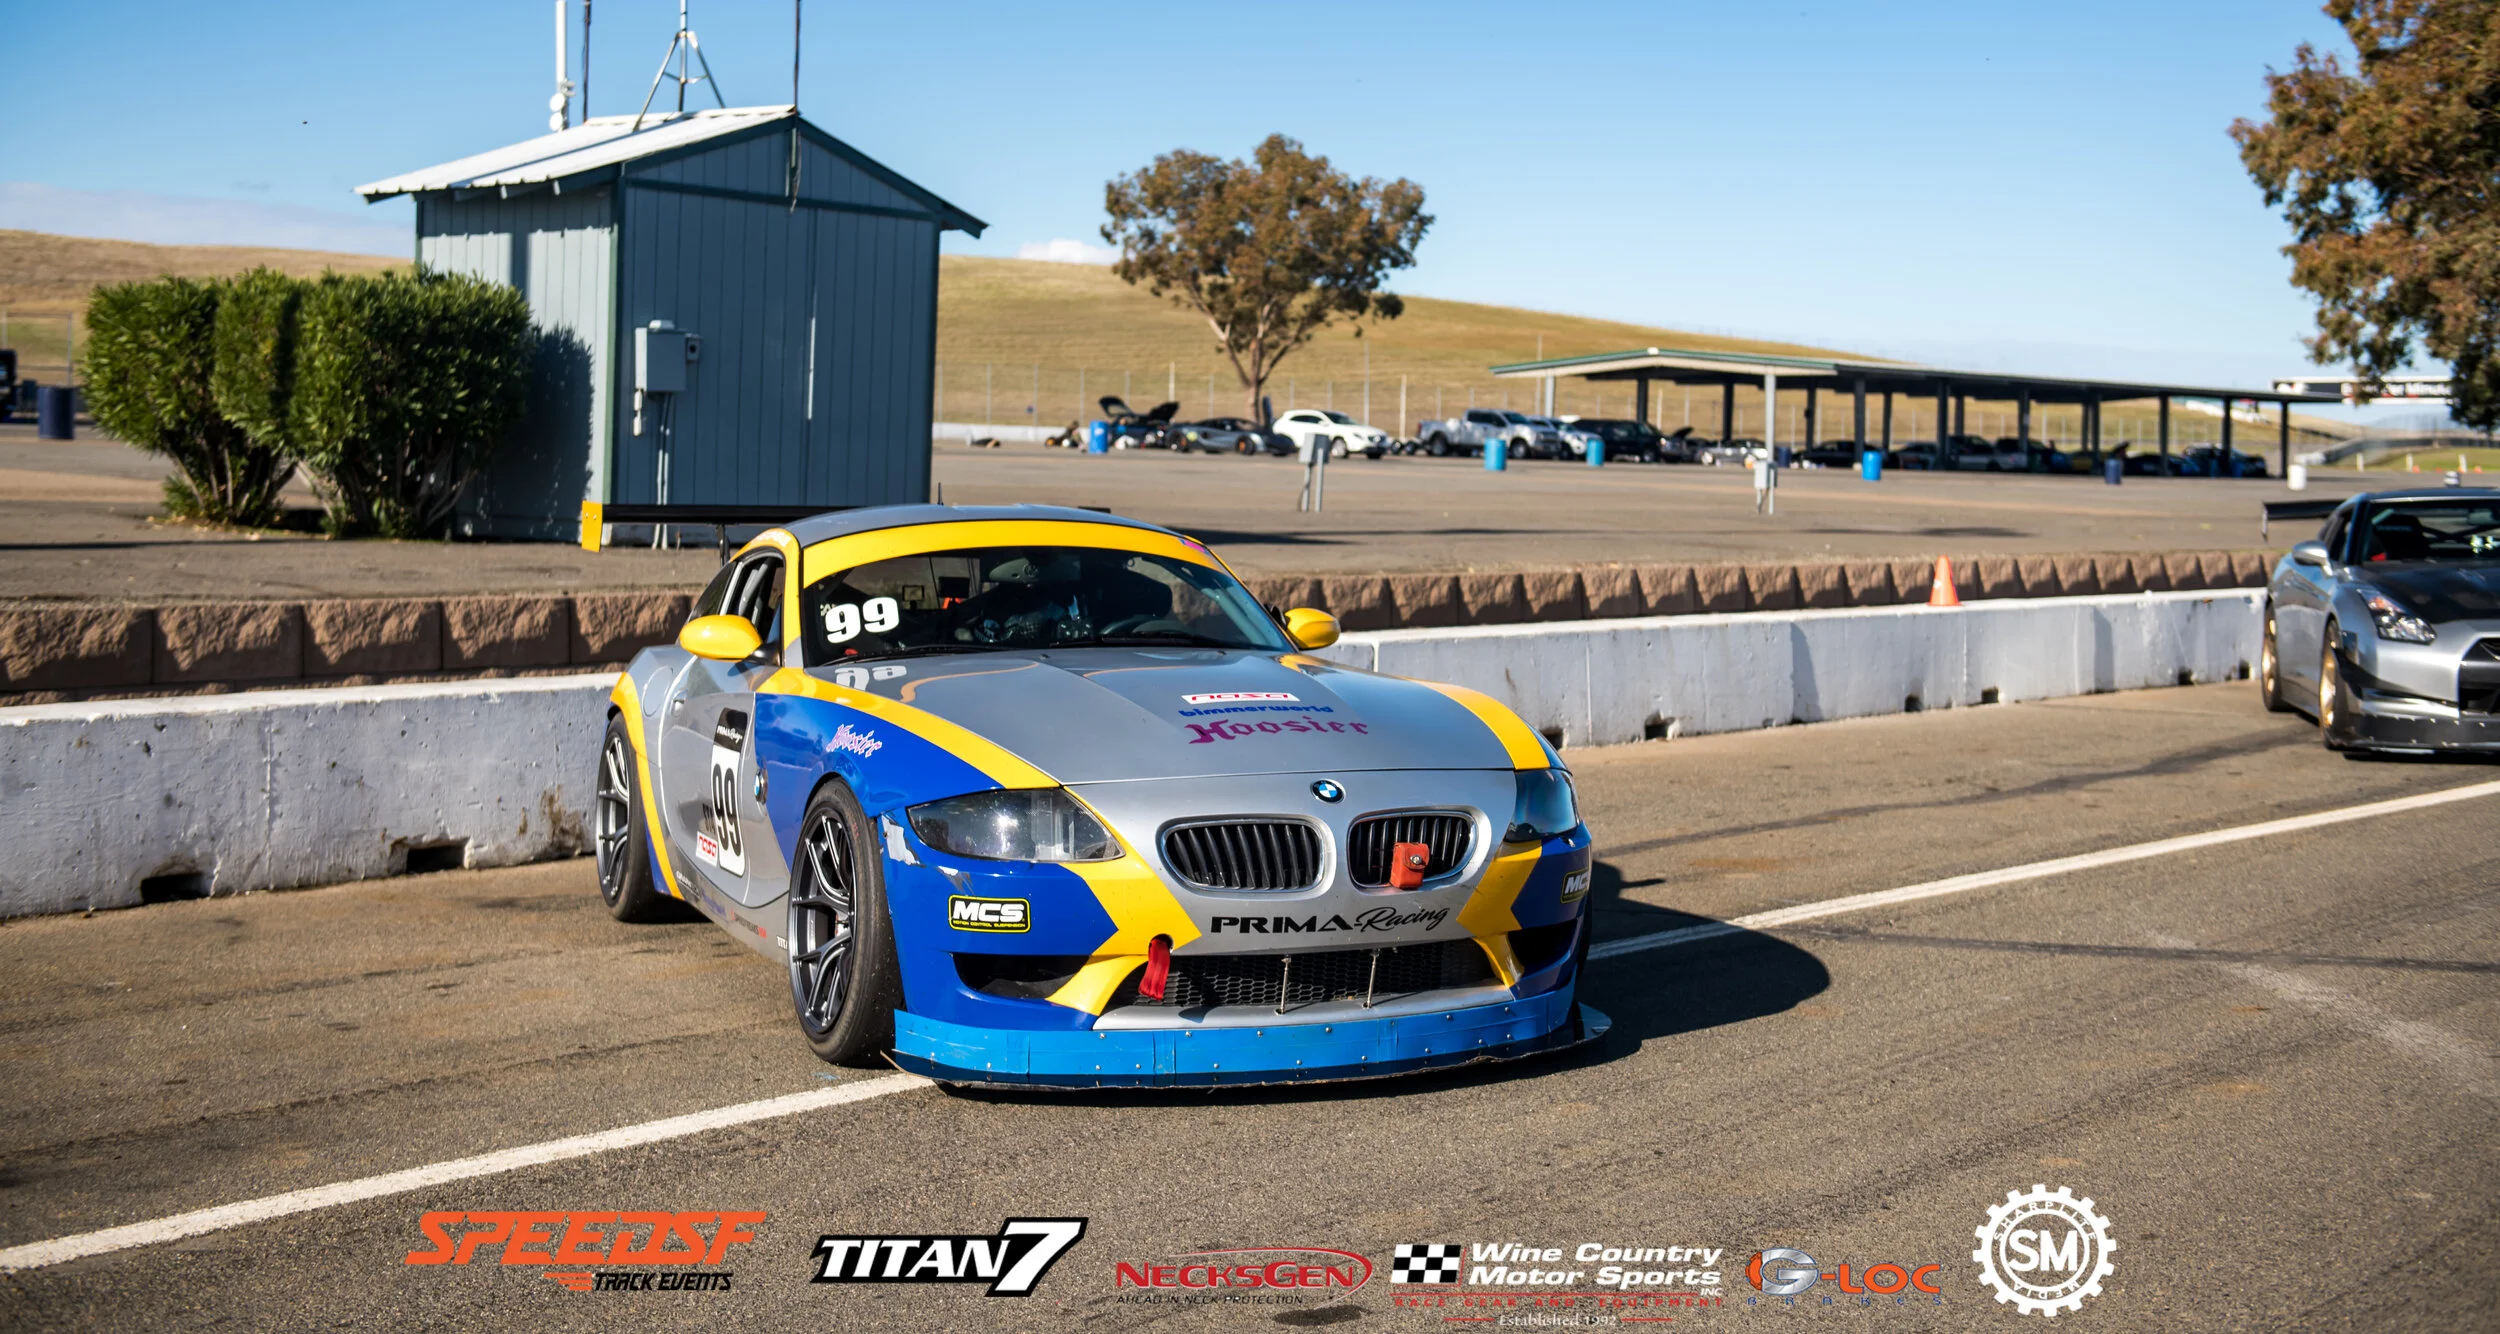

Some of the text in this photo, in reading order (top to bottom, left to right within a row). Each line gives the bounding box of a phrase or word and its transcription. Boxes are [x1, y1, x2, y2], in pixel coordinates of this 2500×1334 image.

[825, 596, 900, 643] 99
[1184, 715, 1369, 744] Hoosier
[712, 763, 741, 857] 99
[1564, 873, 1588, 894] MC
[953, 900, 1024, 922] MCS
